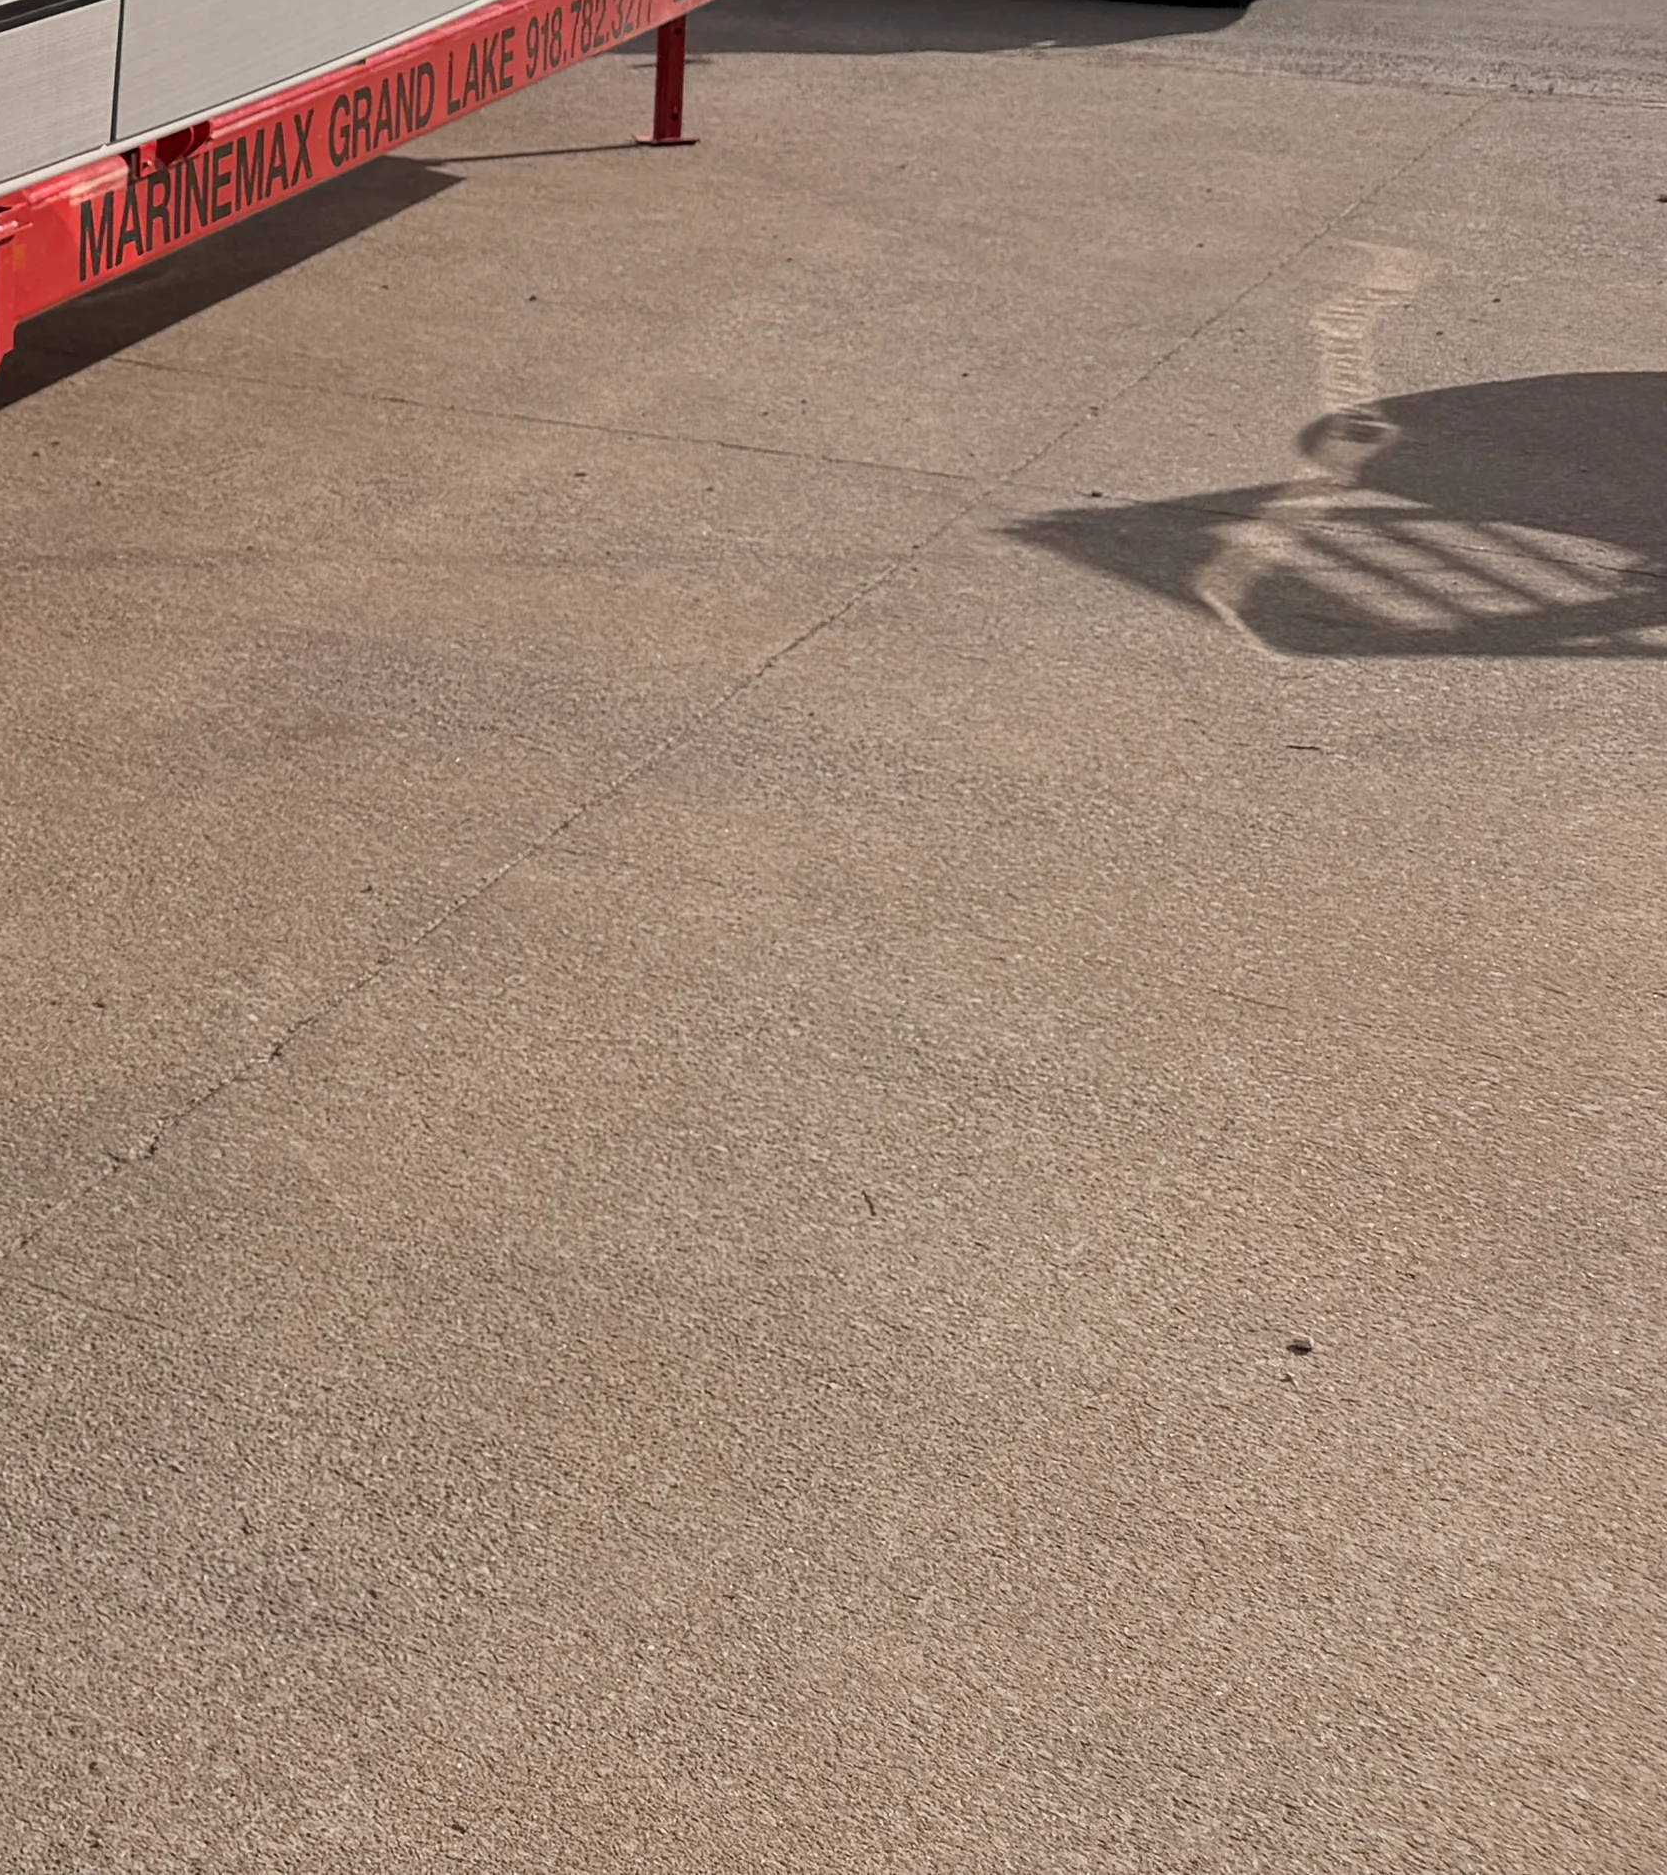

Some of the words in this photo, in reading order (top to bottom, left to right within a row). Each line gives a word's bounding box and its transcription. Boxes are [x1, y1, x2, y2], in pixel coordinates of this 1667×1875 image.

[78, 108, 315, 282] MARINEMAX
[328, 62, 436, 168] GRAND
[446, 25, 515, 113] LAKE
